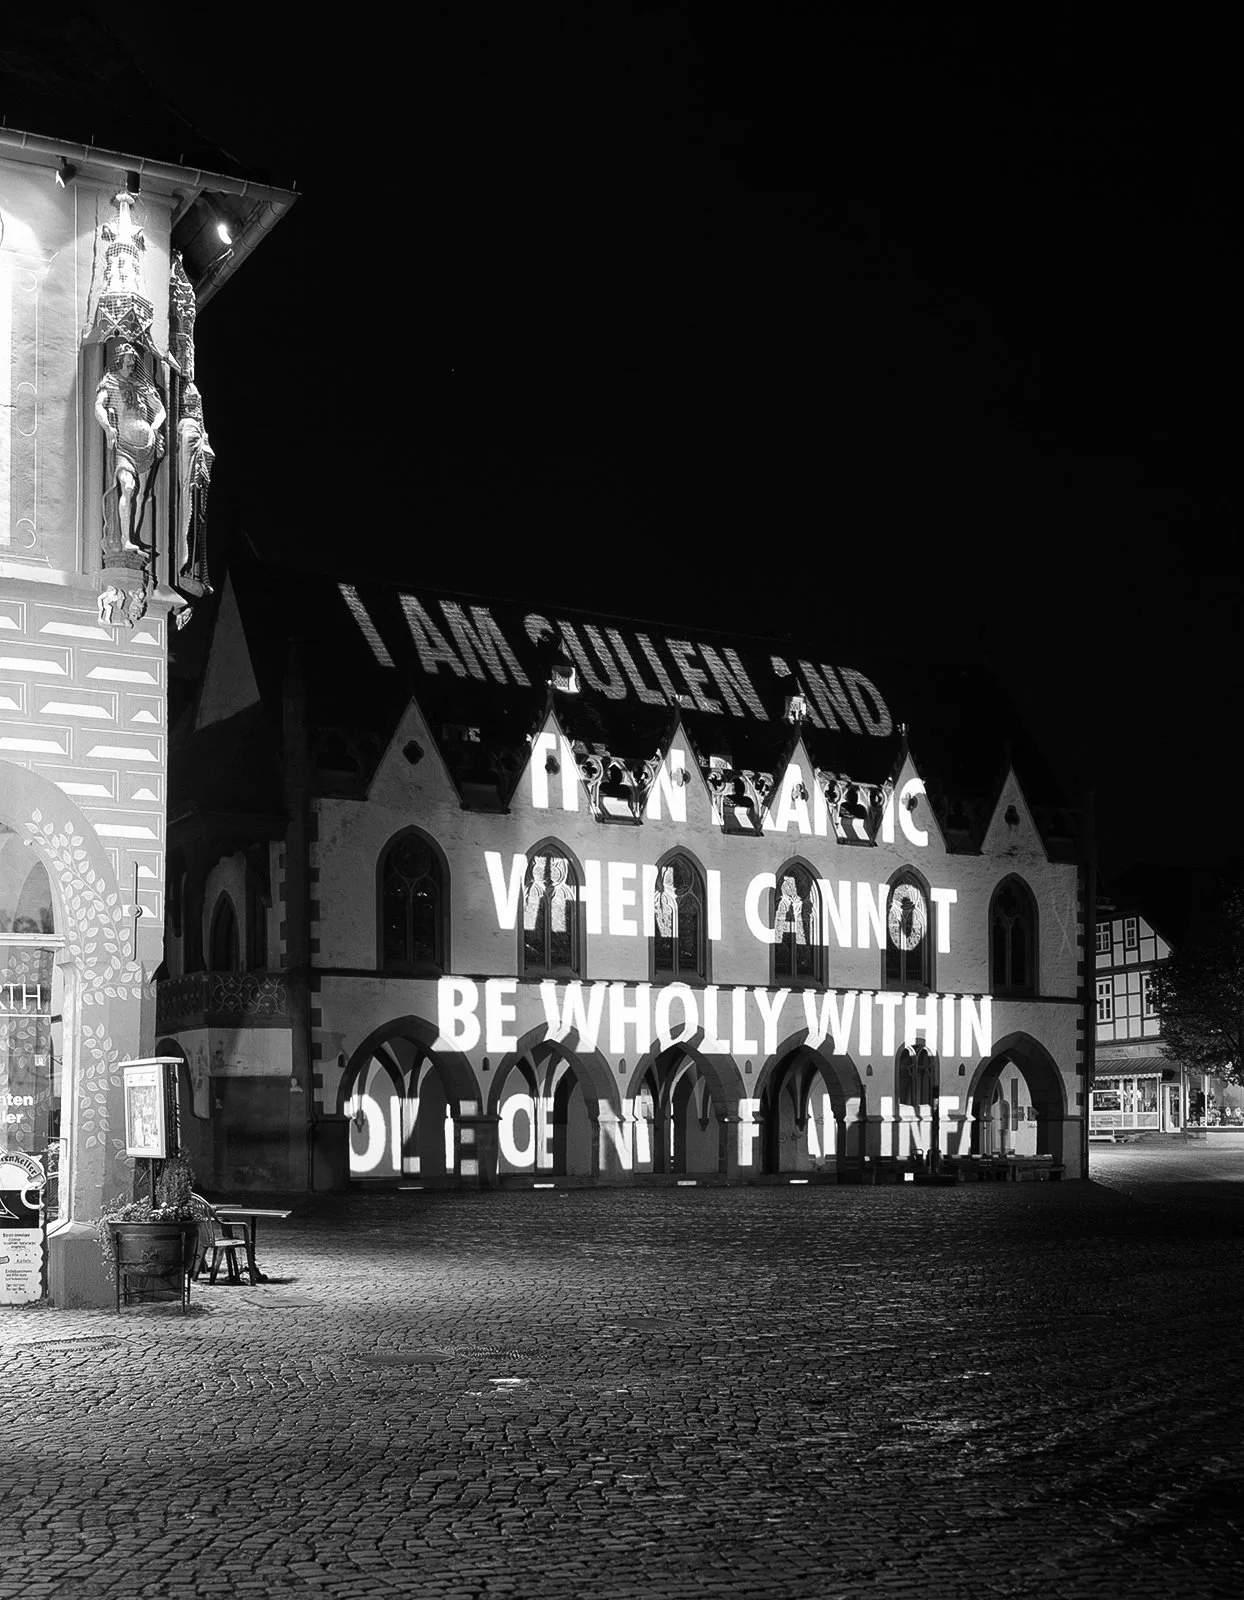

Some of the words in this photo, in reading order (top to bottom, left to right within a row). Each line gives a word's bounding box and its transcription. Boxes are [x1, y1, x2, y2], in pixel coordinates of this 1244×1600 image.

[399, 592, 532, 687] AM
[483, 850, 680, 938] WHEN
[743, 871, 958, 953] CANNOT
[435, 974, 520, 1053] BE
[538, 980, 791, 1056] WHOLLY
[802, 987, 994, 1057] WITHIN
